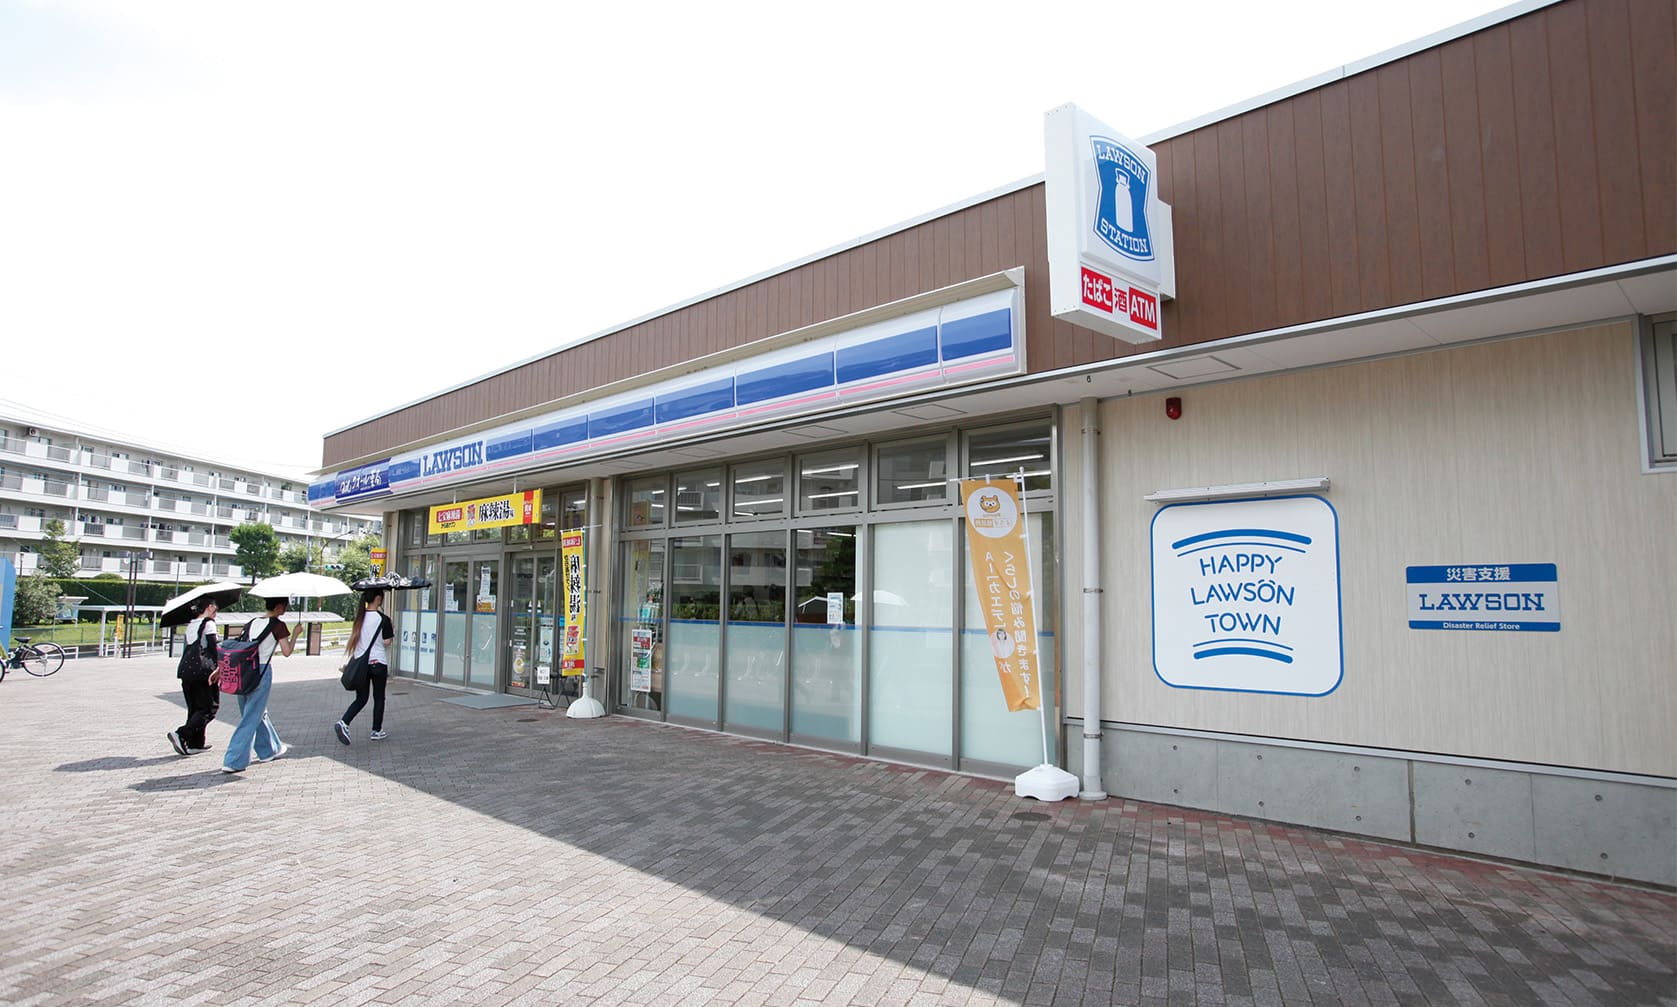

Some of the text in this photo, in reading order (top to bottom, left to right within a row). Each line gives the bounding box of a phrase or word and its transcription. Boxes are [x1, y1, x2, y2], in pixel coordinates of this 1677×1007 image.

[1096, 144, 1146, 185] LAWSON
[1100, 217, 1148, 253] STATION
[1082, 273, 1156, 324] たばこ 酒 ATM
[423, 440, 483, 476] LAWSON
[1200, 554, 1282, 576] HAPPY
[1446, 566, 1511, 581] 災害支援
[1190, 580, 1294, 606] LAWSON
[1419, 593, 1545, 611] LAWSON
[1204, 612, 1281, 636] TOWN
[1443, 622, 1473, 630] Disaster
[1475, 622, 1497, 630] Relief
[223, 653, 231, 682] NORTH
